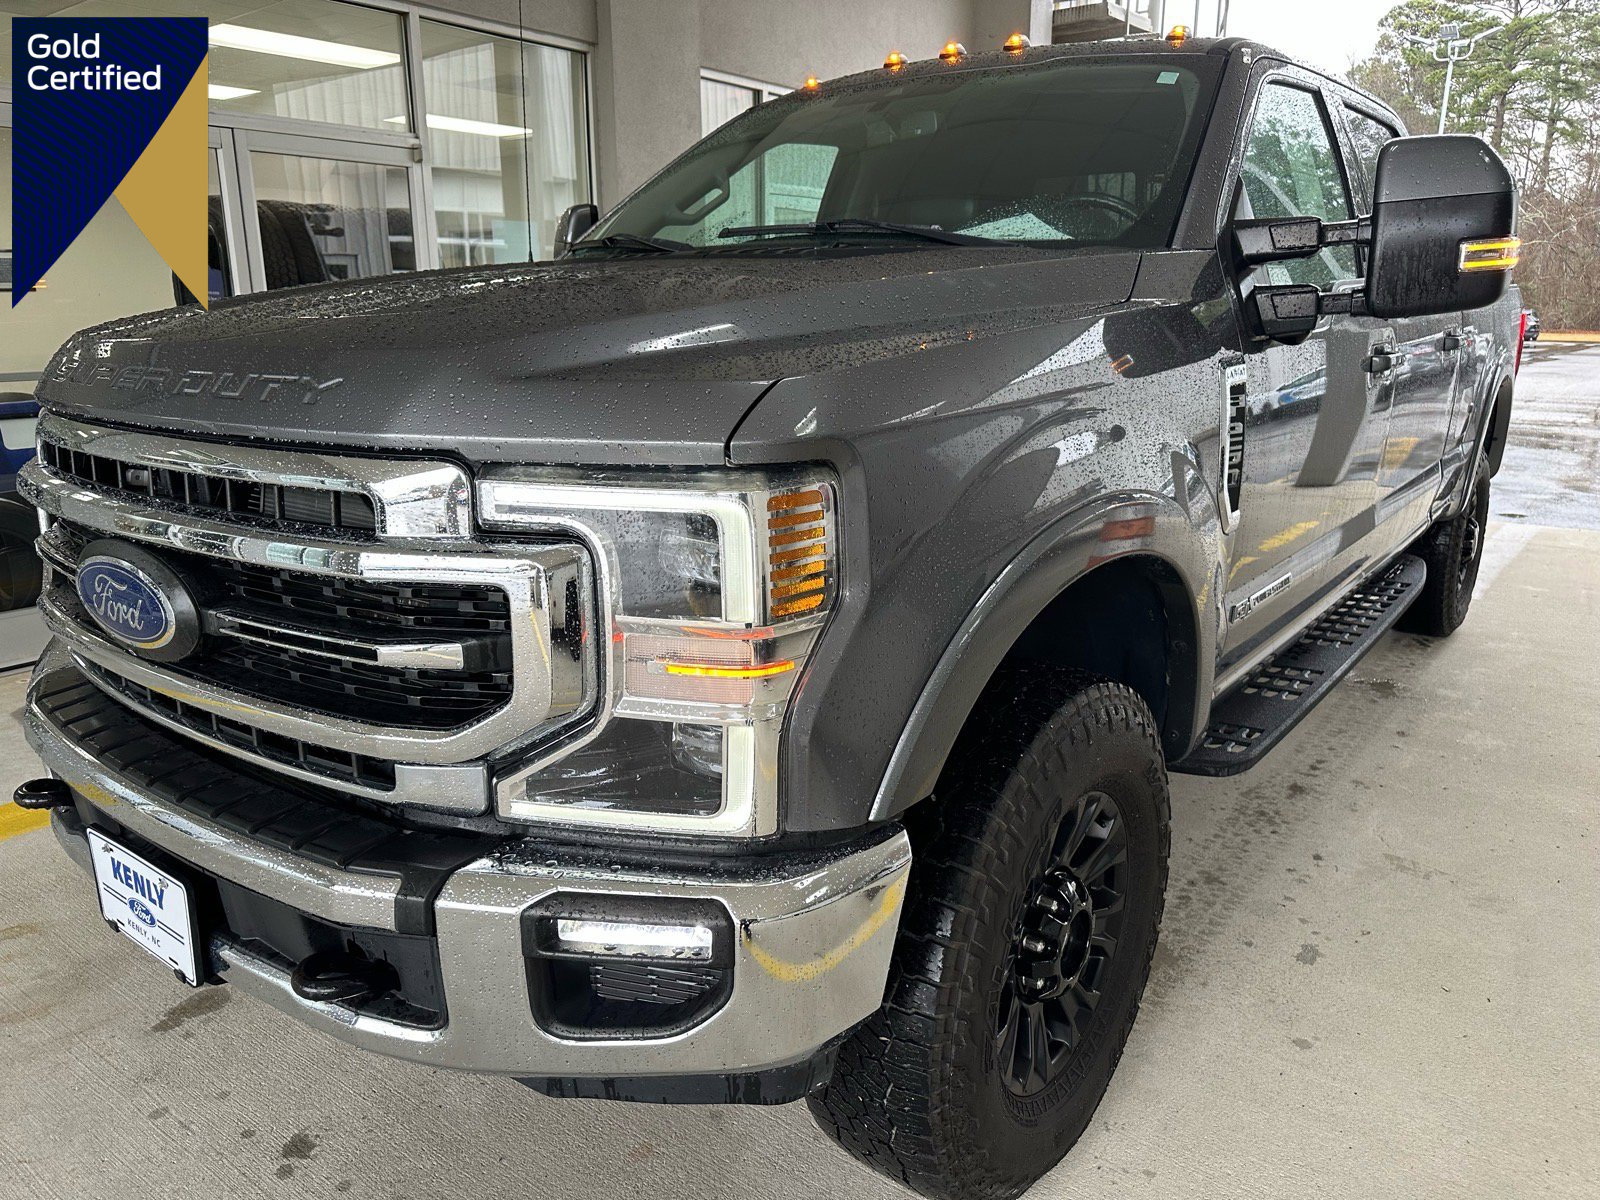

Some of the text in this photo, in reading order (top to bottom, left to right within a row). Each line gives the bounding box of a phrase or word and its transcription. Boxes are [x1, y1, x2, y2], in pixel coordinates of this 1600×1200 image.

[172, 370, 344, 405] DUTY
[93, 574, 144, 631] Ford
[110, 856, 165, 910] KENLY
[133, 901, 152, 924] Ford
[151, 935, 161, 948] NC
